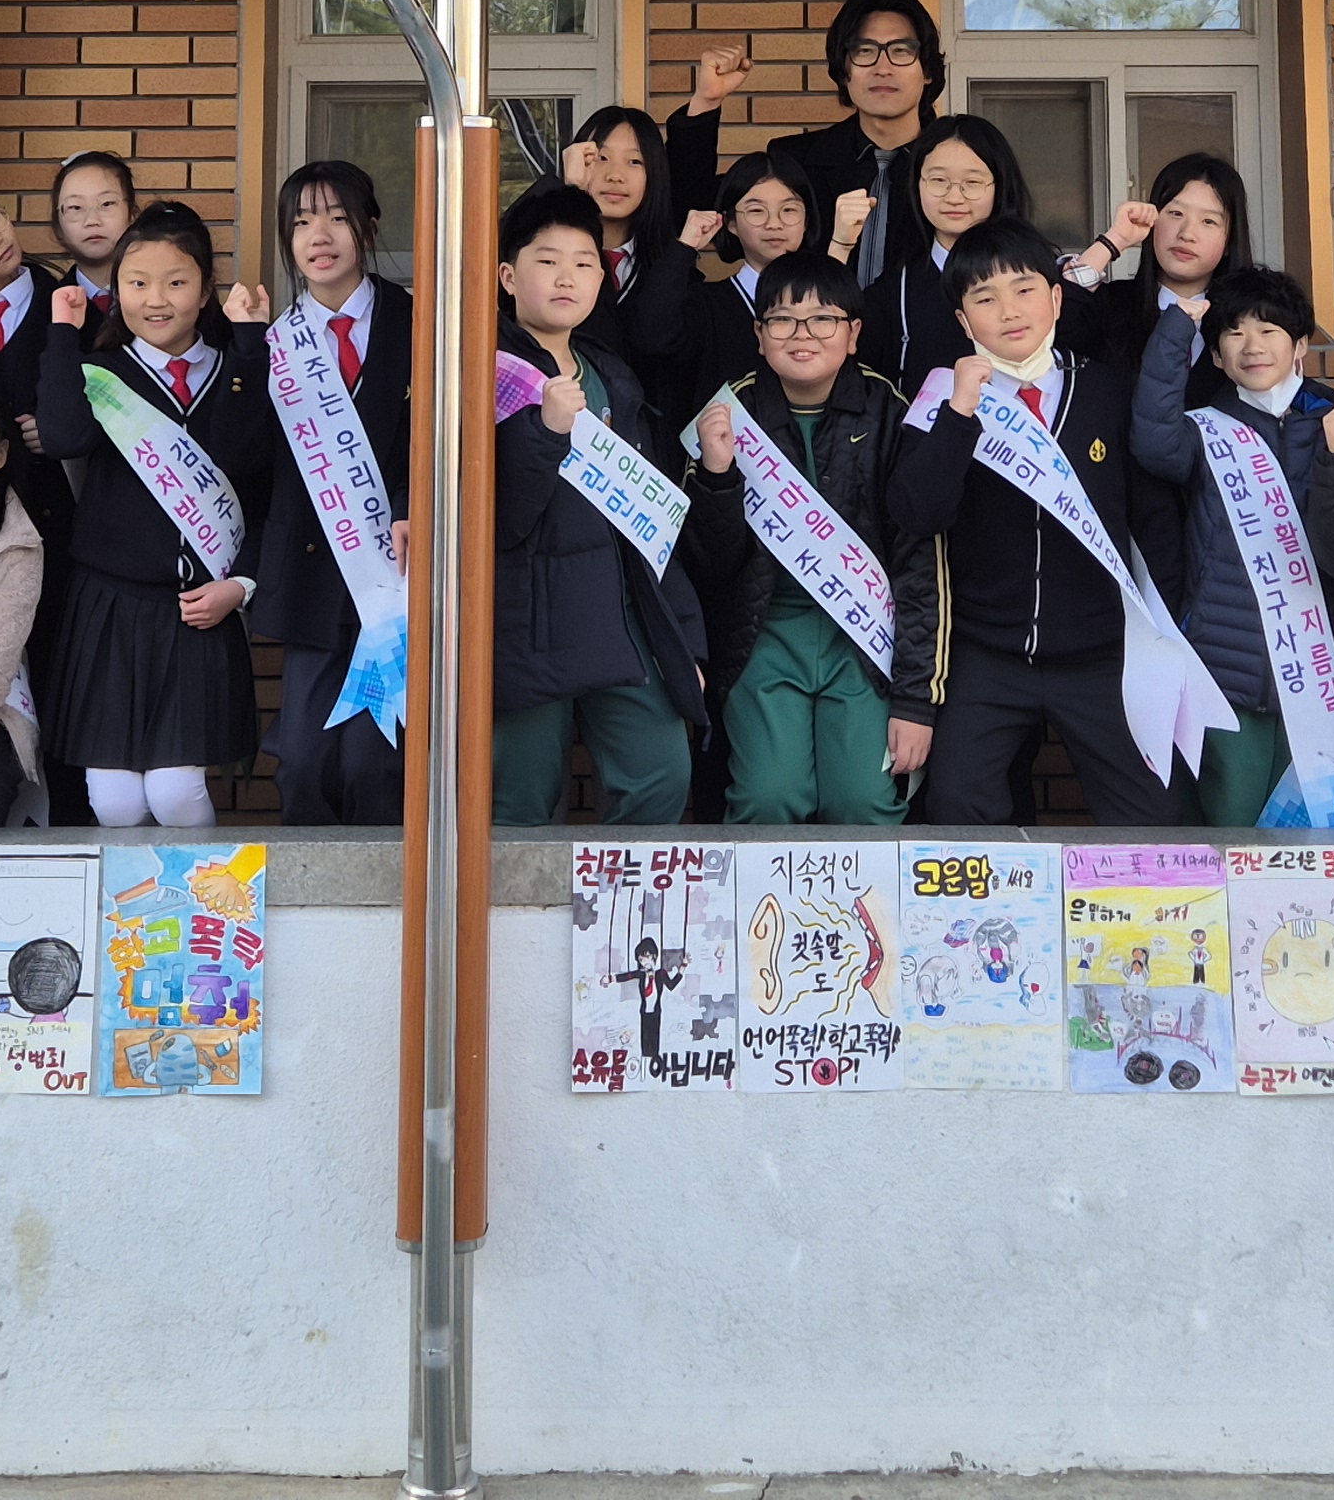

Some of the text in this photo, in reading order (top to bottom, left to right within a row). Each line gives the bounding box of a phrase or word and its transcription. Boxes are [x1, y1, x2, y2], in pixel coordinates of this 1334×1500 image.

[279, 298, 344, 416] 감싸주는
[135, 439, 221, 554] 상처받은
[293, 418, 360, 551] 친구마음
[734, 427, 835, 540] 친구마음
[1232, 420, 1312, 585] 바른생활의
[1193, 406, 1304, 693] 왕따없는 친구사랑
[576, 846, 733, 890] 친구는 당신의
[770, 849, 862, 897] 지속적인
[1007, 867, 1034, 889] 써요
[791, 930, 844, 962] 귓속말
[131, 963, 251, 1026] 멈춰
[812, 972, 834, 993] 도
[26, 1026, 45, 1036] SNS
[7, 1047, 66, 1071] 성범죄
[43, 1070, 88, 1091] OUT
